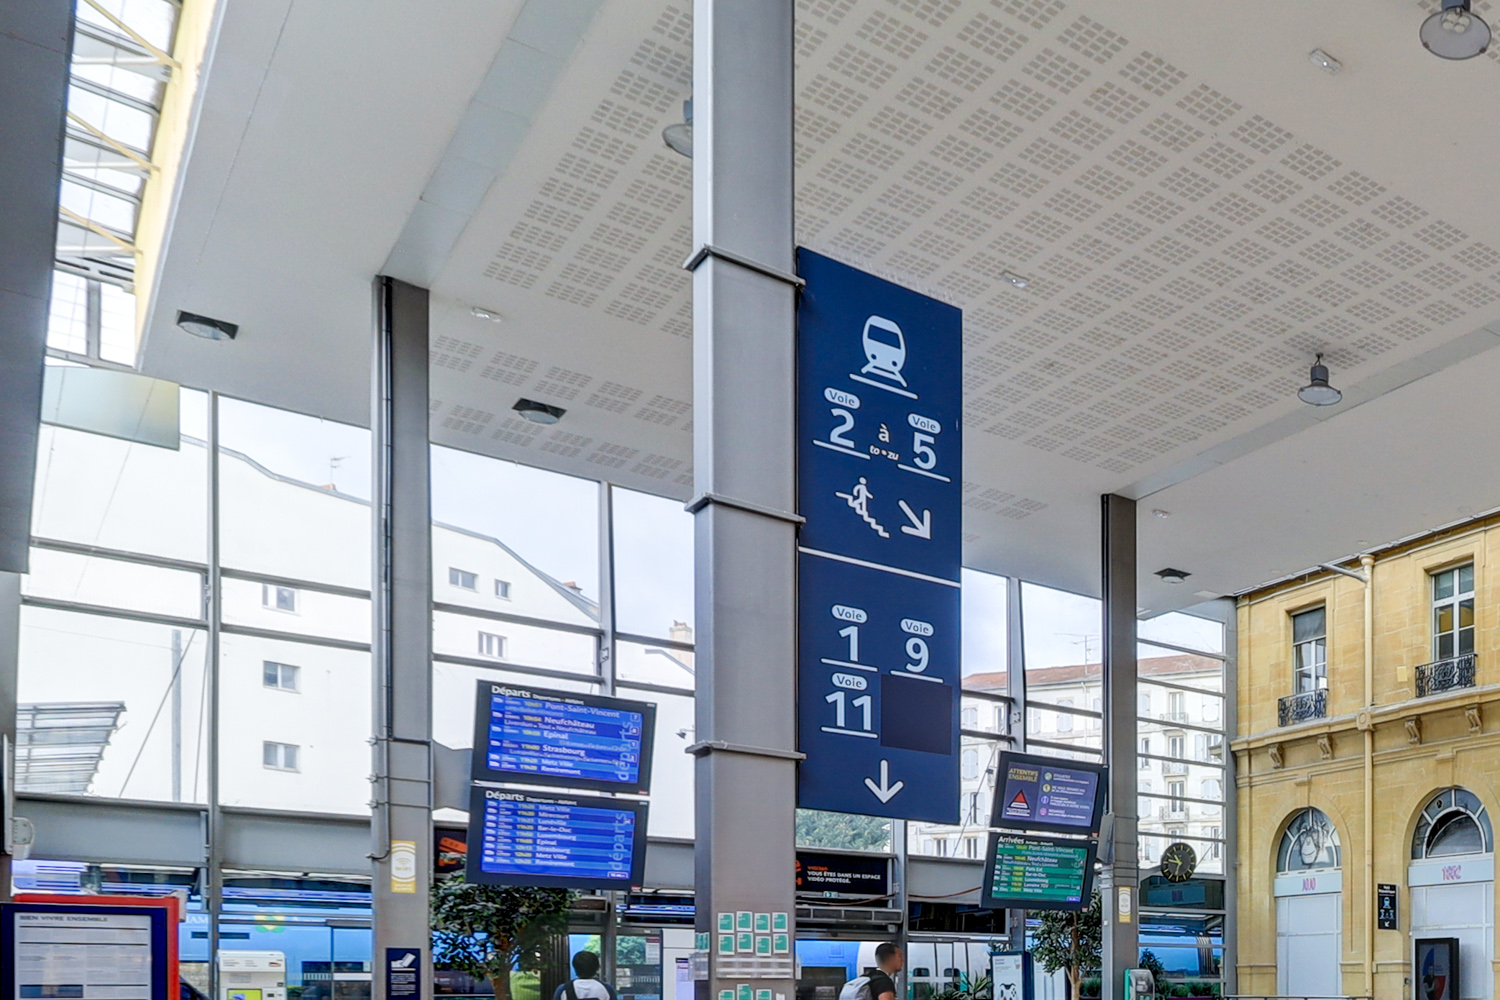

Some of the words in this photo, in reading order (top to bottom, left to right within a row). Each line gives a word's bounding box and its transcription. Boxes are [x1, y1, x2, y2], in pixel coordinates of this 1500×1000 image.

[828, 390, 855, 407] Voie
[912, 415, 937, 432] Voie
[830, 408, 855, 448] 2
[913, 432, 937, 470] 5
[869, 445, 880, 456] to
[887, 451, 899, 461] zu
[836, 607, 863, 621] Voie
[905, 621, 930, 635] Voie
[838, 625, 859, 662] 1
[905, 637, 930, 673] 9
[836, 674, 862, 689] Voie
[492, 685, 531, 699] Départs
[545, 702, 620, 718] Pont-Saint-Vincent
[825, 691, 872, 731] 11
[544, 716, 595, 730] Neufchâteau
[543, 731, 569, 741] Epinal
[542, 744, 586, 758] Strasbourg
[541, 765, 581, 776] Remiremont
[485, 790, 525, 803] Départs
[537, 838, 557, 847] Epinal
[608, 813, 627, 871] départs
[998, 836, 1024, 845] Arrivées
